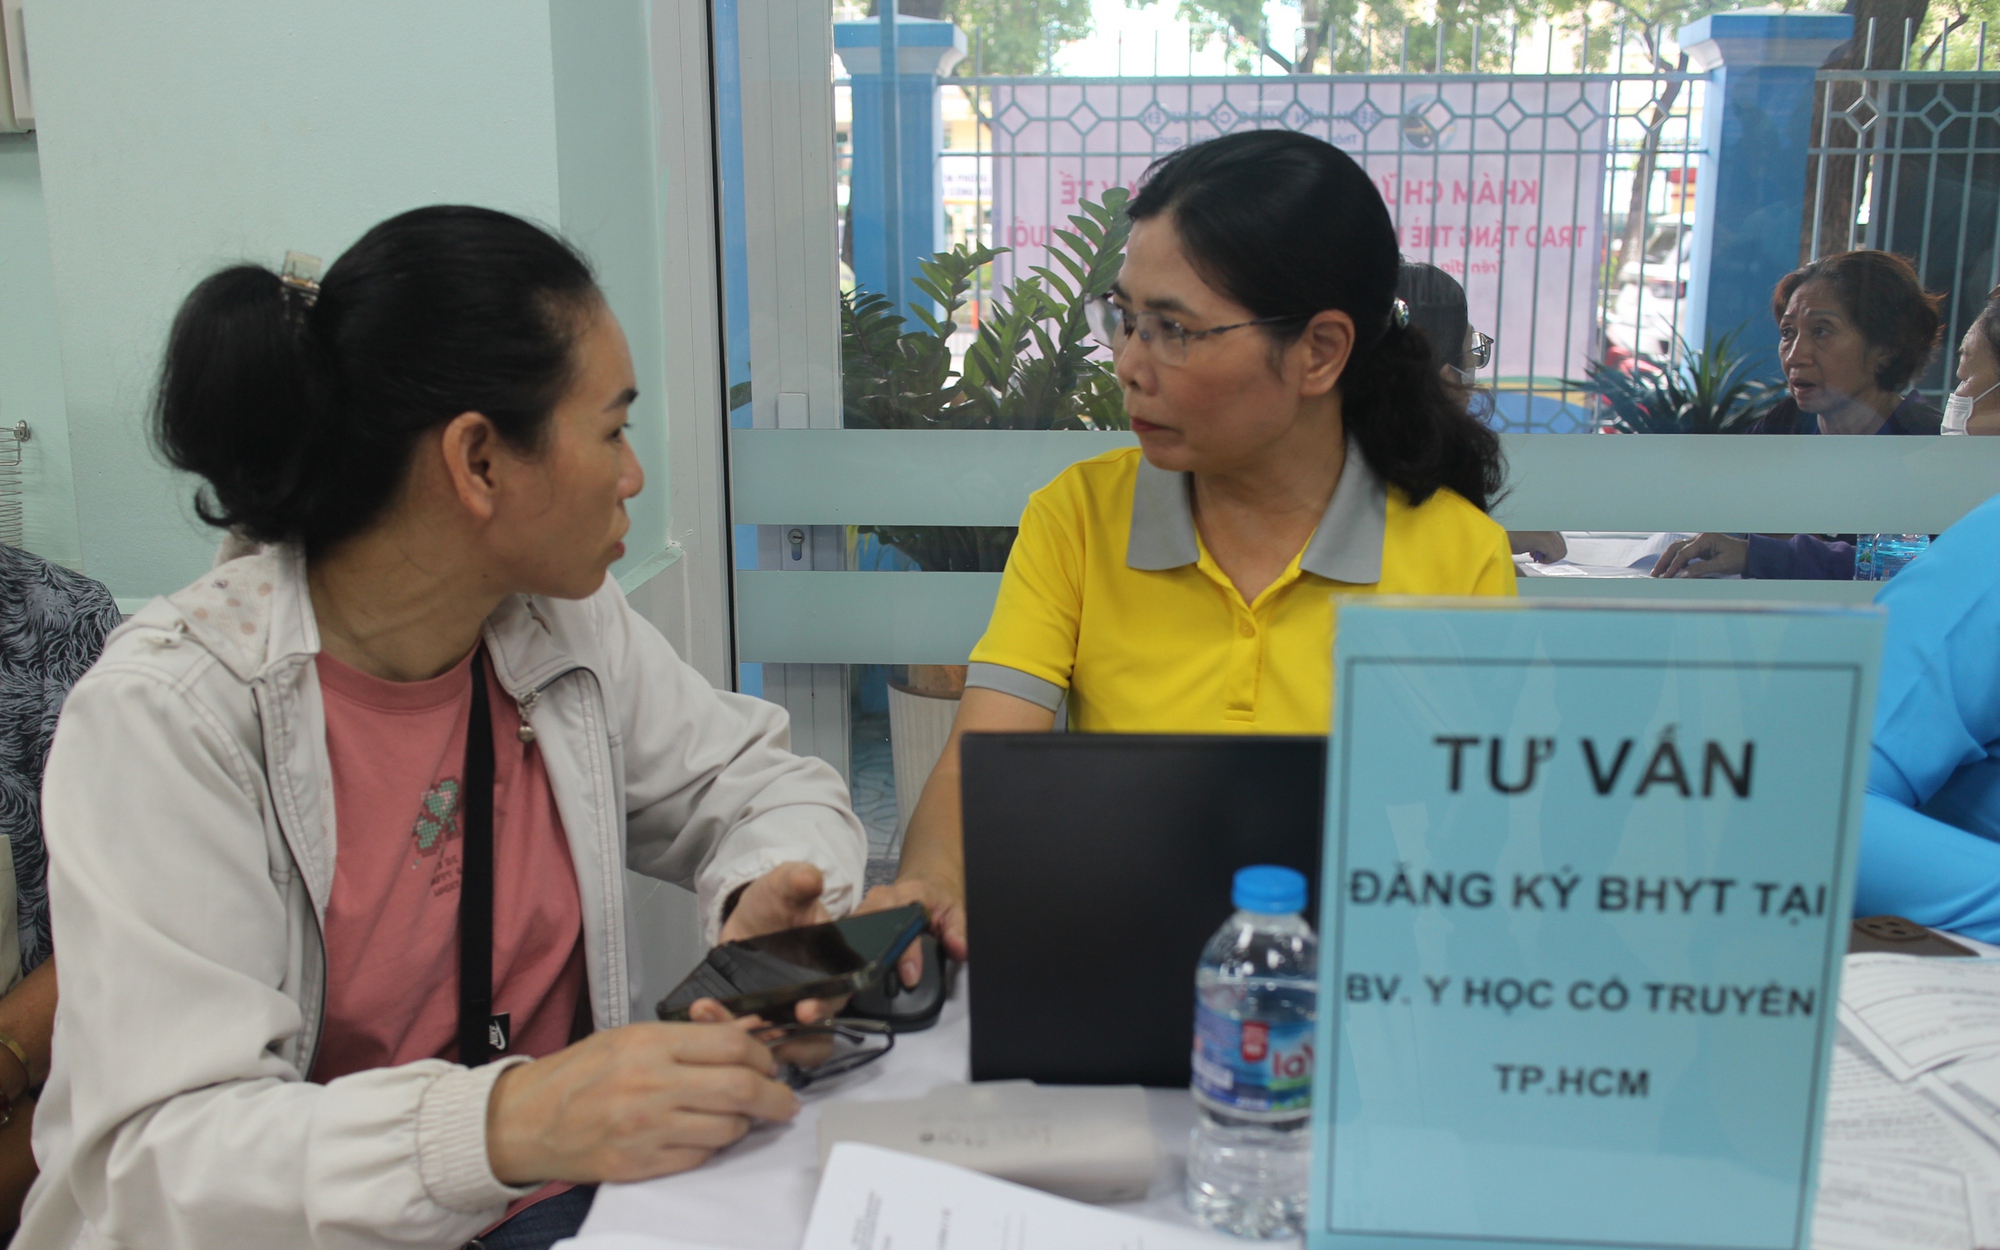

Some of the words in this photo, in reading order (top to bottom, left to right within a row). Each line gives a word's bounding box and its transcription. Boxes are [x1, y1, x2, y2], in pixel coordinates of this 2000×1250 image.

[1433, 735, 1556, 795] TƯ
[1579, 723, 1757, 800] VẤN
[1346, 861, 1495, 908] ĐĂNG
[1596, 874, 1737, 916] BHYT
[1751, 881, 1827, 927] TẠI
[1346, 973, 1411, 1006] BV.
[1422, 975, 1453, 1007] Y
[1462, 977, 1555, 1017] HỌC
[1494, 1064, 1651, 1099] TP.HCM
